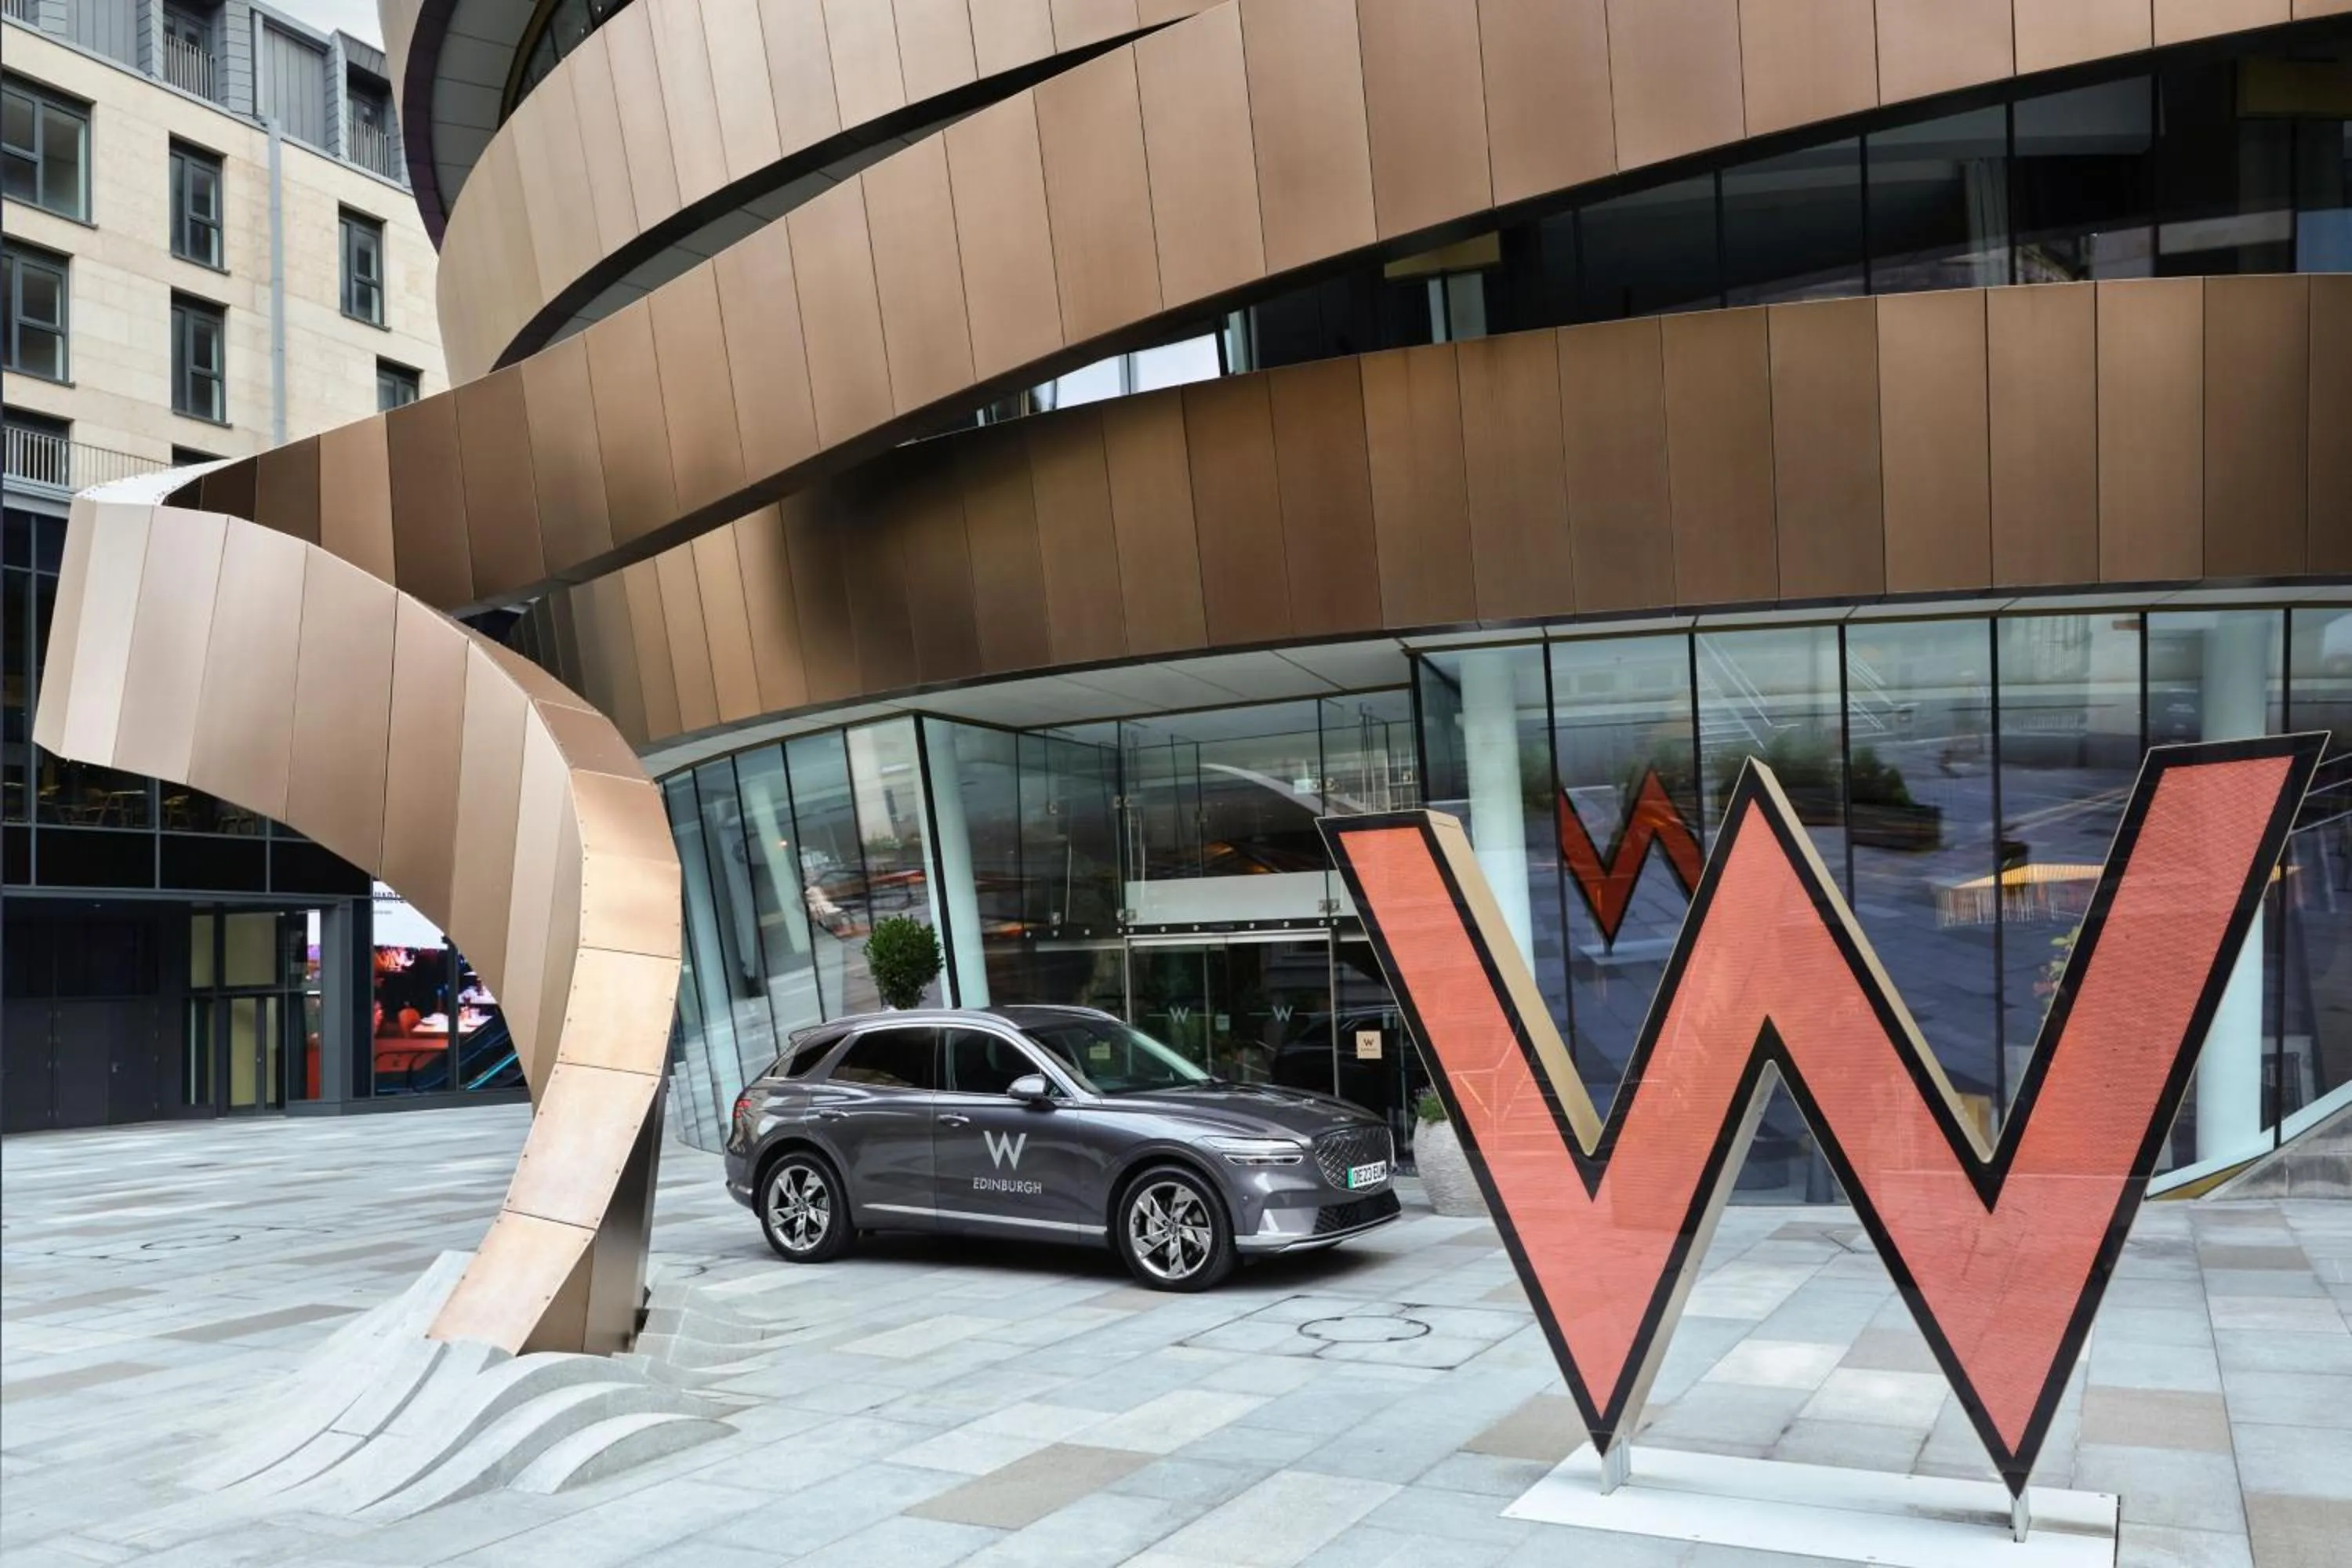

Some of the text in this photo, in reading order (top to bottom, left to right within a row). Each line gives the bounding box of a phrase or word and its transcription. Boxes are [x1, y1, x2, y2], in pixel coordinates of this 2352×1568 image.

[1169, 1007, 1189, 1024] W
[1272, 1005, 1294, 1022] W
[1363, 1037, 1374, 1047] W
[1314, 731, 2331, 1501] W
[983, 1130, 1028, 1171] W
[973, 1177, 1043, 1194] EDINBURGH
